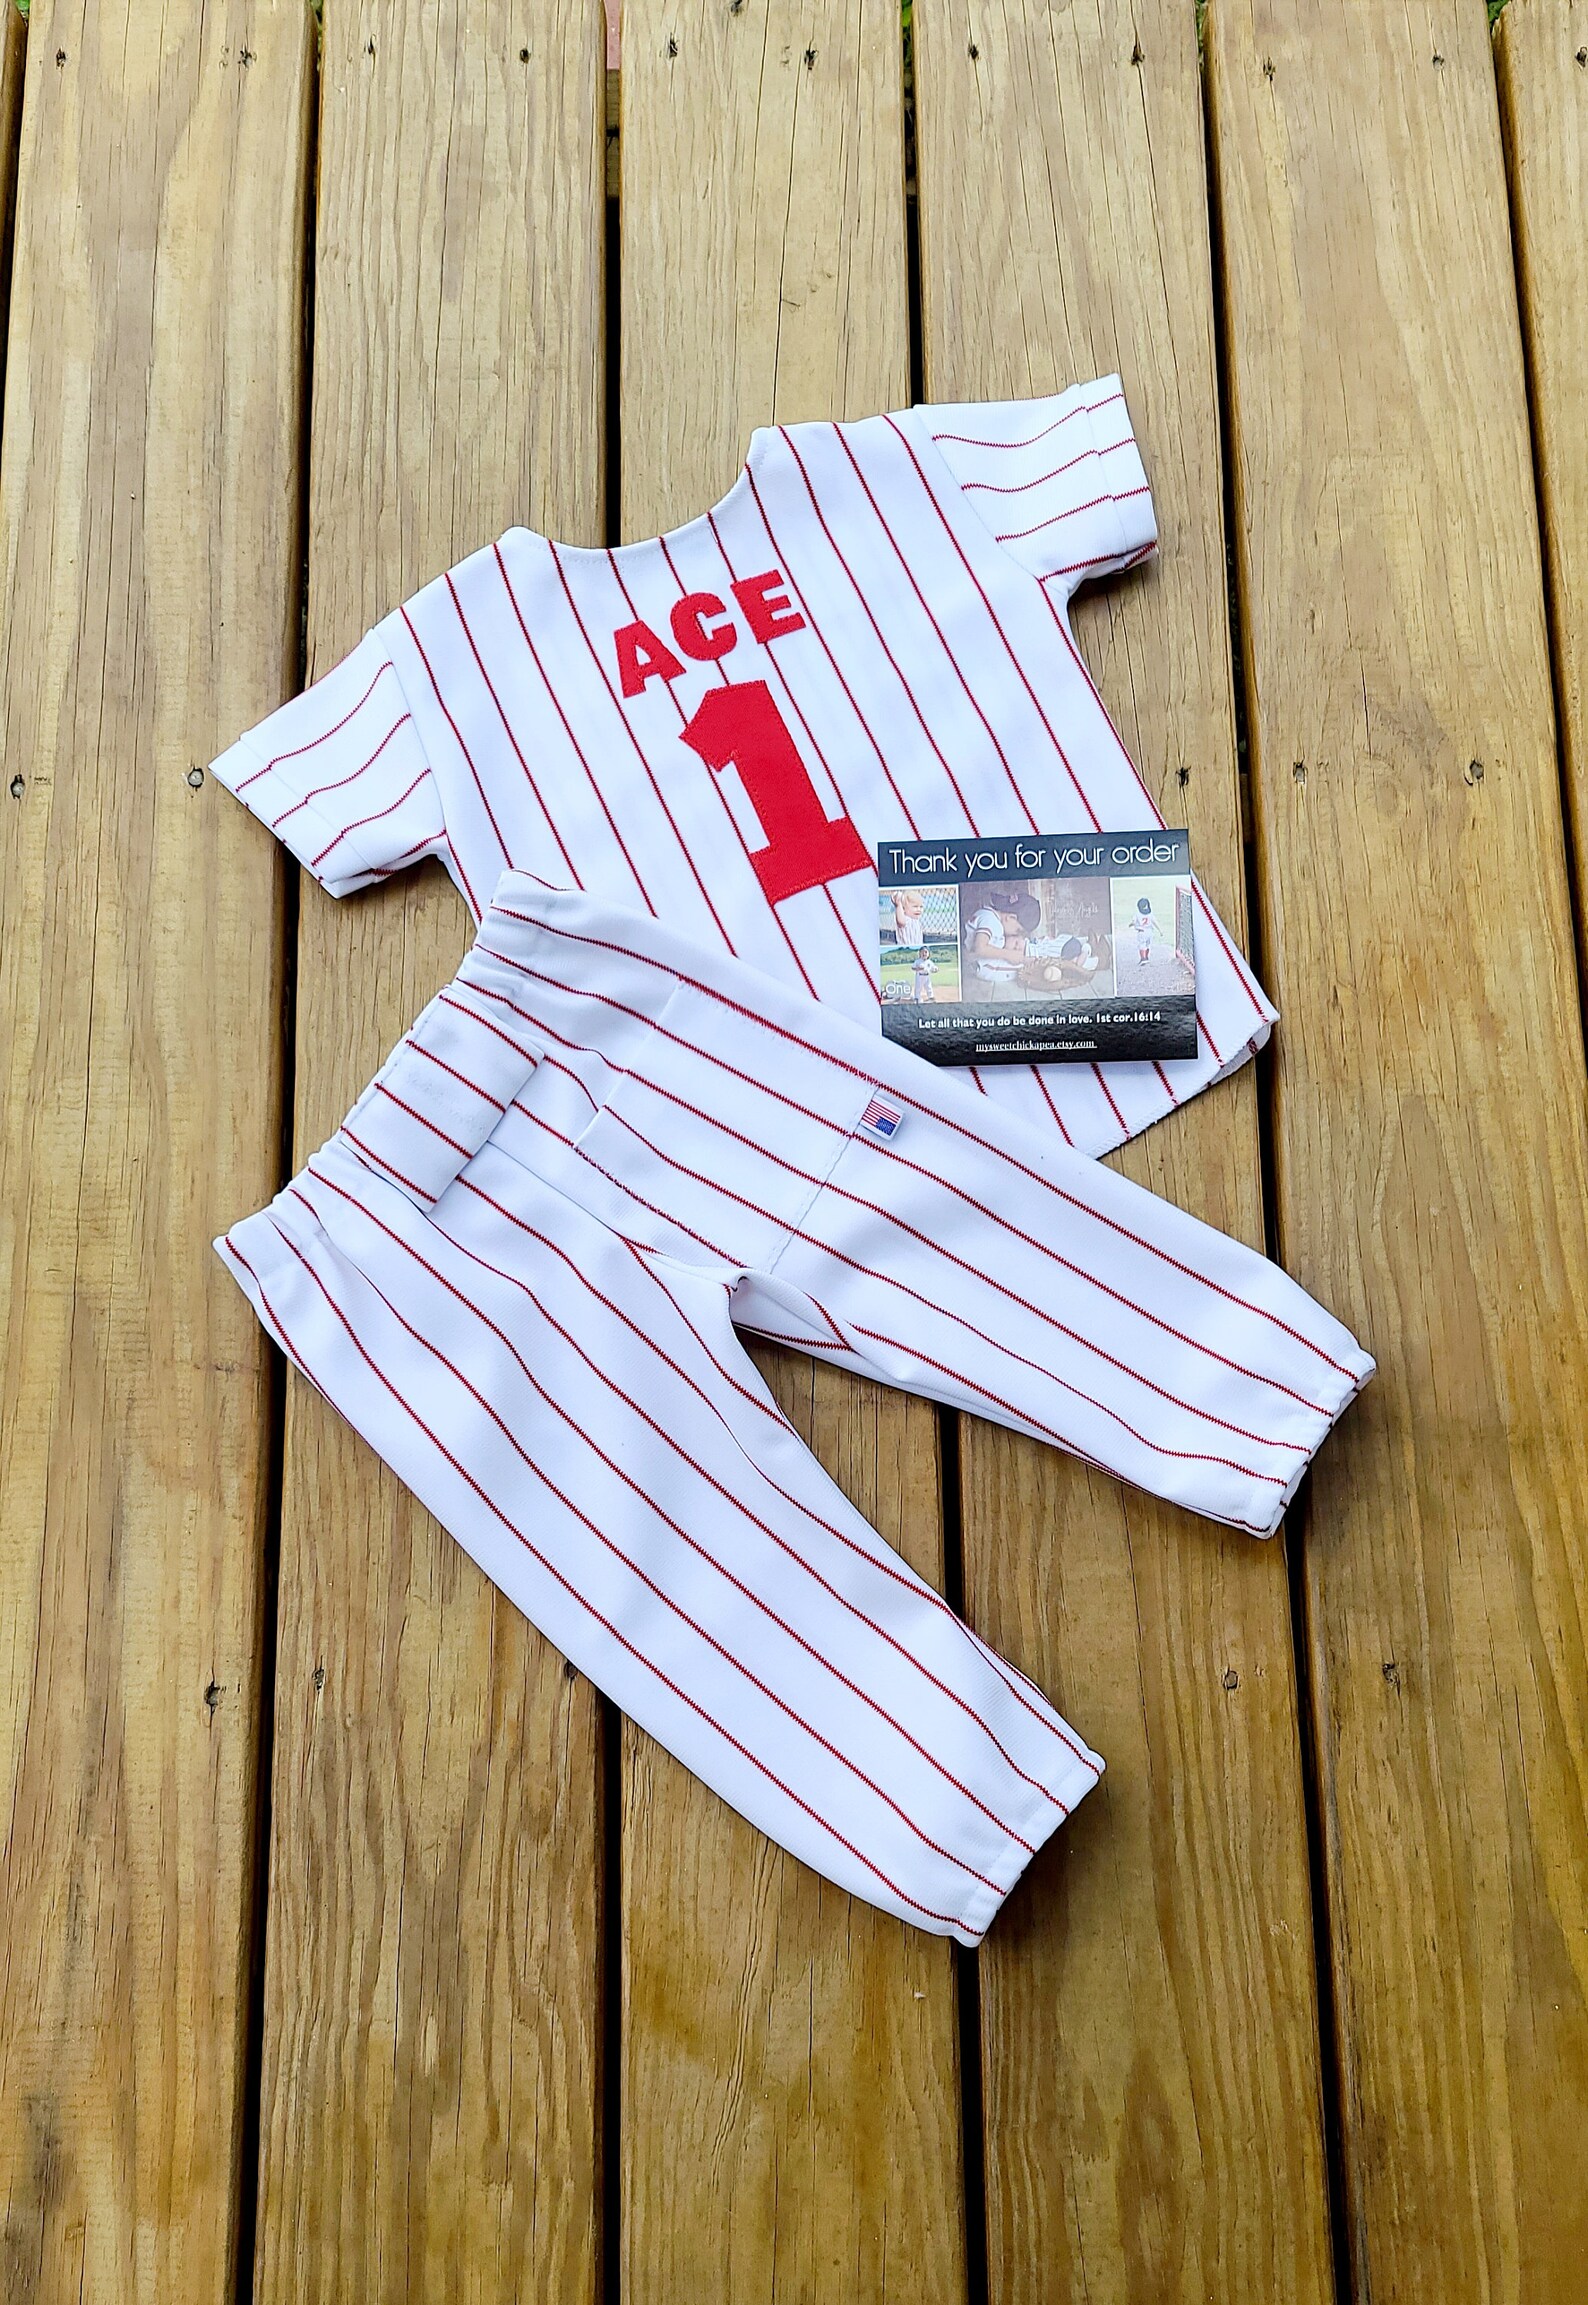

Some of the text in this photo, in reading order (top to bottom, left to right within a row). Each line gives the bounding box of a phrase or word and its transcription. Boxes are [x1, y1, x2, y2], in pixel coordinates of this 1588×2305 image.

[614, 569, 806, 698] ACE
[679, 680, 872, 907] 1
[888, 838, 1180, 878] Thank you for your order
[918, 1018, 936, 1029] Let
[938, 1017, 950, 1028] all
[952, 1017, 974, 1028] that
[976, 1018, 995, 1029] you
[997, 1016, 1011, 1026] do
[1013, 1015, 1026, 1026] be
[1028, 1015, 1054, 1025] done
[1056, 1014, 1066, 1024] in
[1068, 1013, 1093, 1024] love.
[1096, 1012, 1112, 1023] 1st
[975, 1040, 1097, 1052] mysweetchickapea.etsy.com
